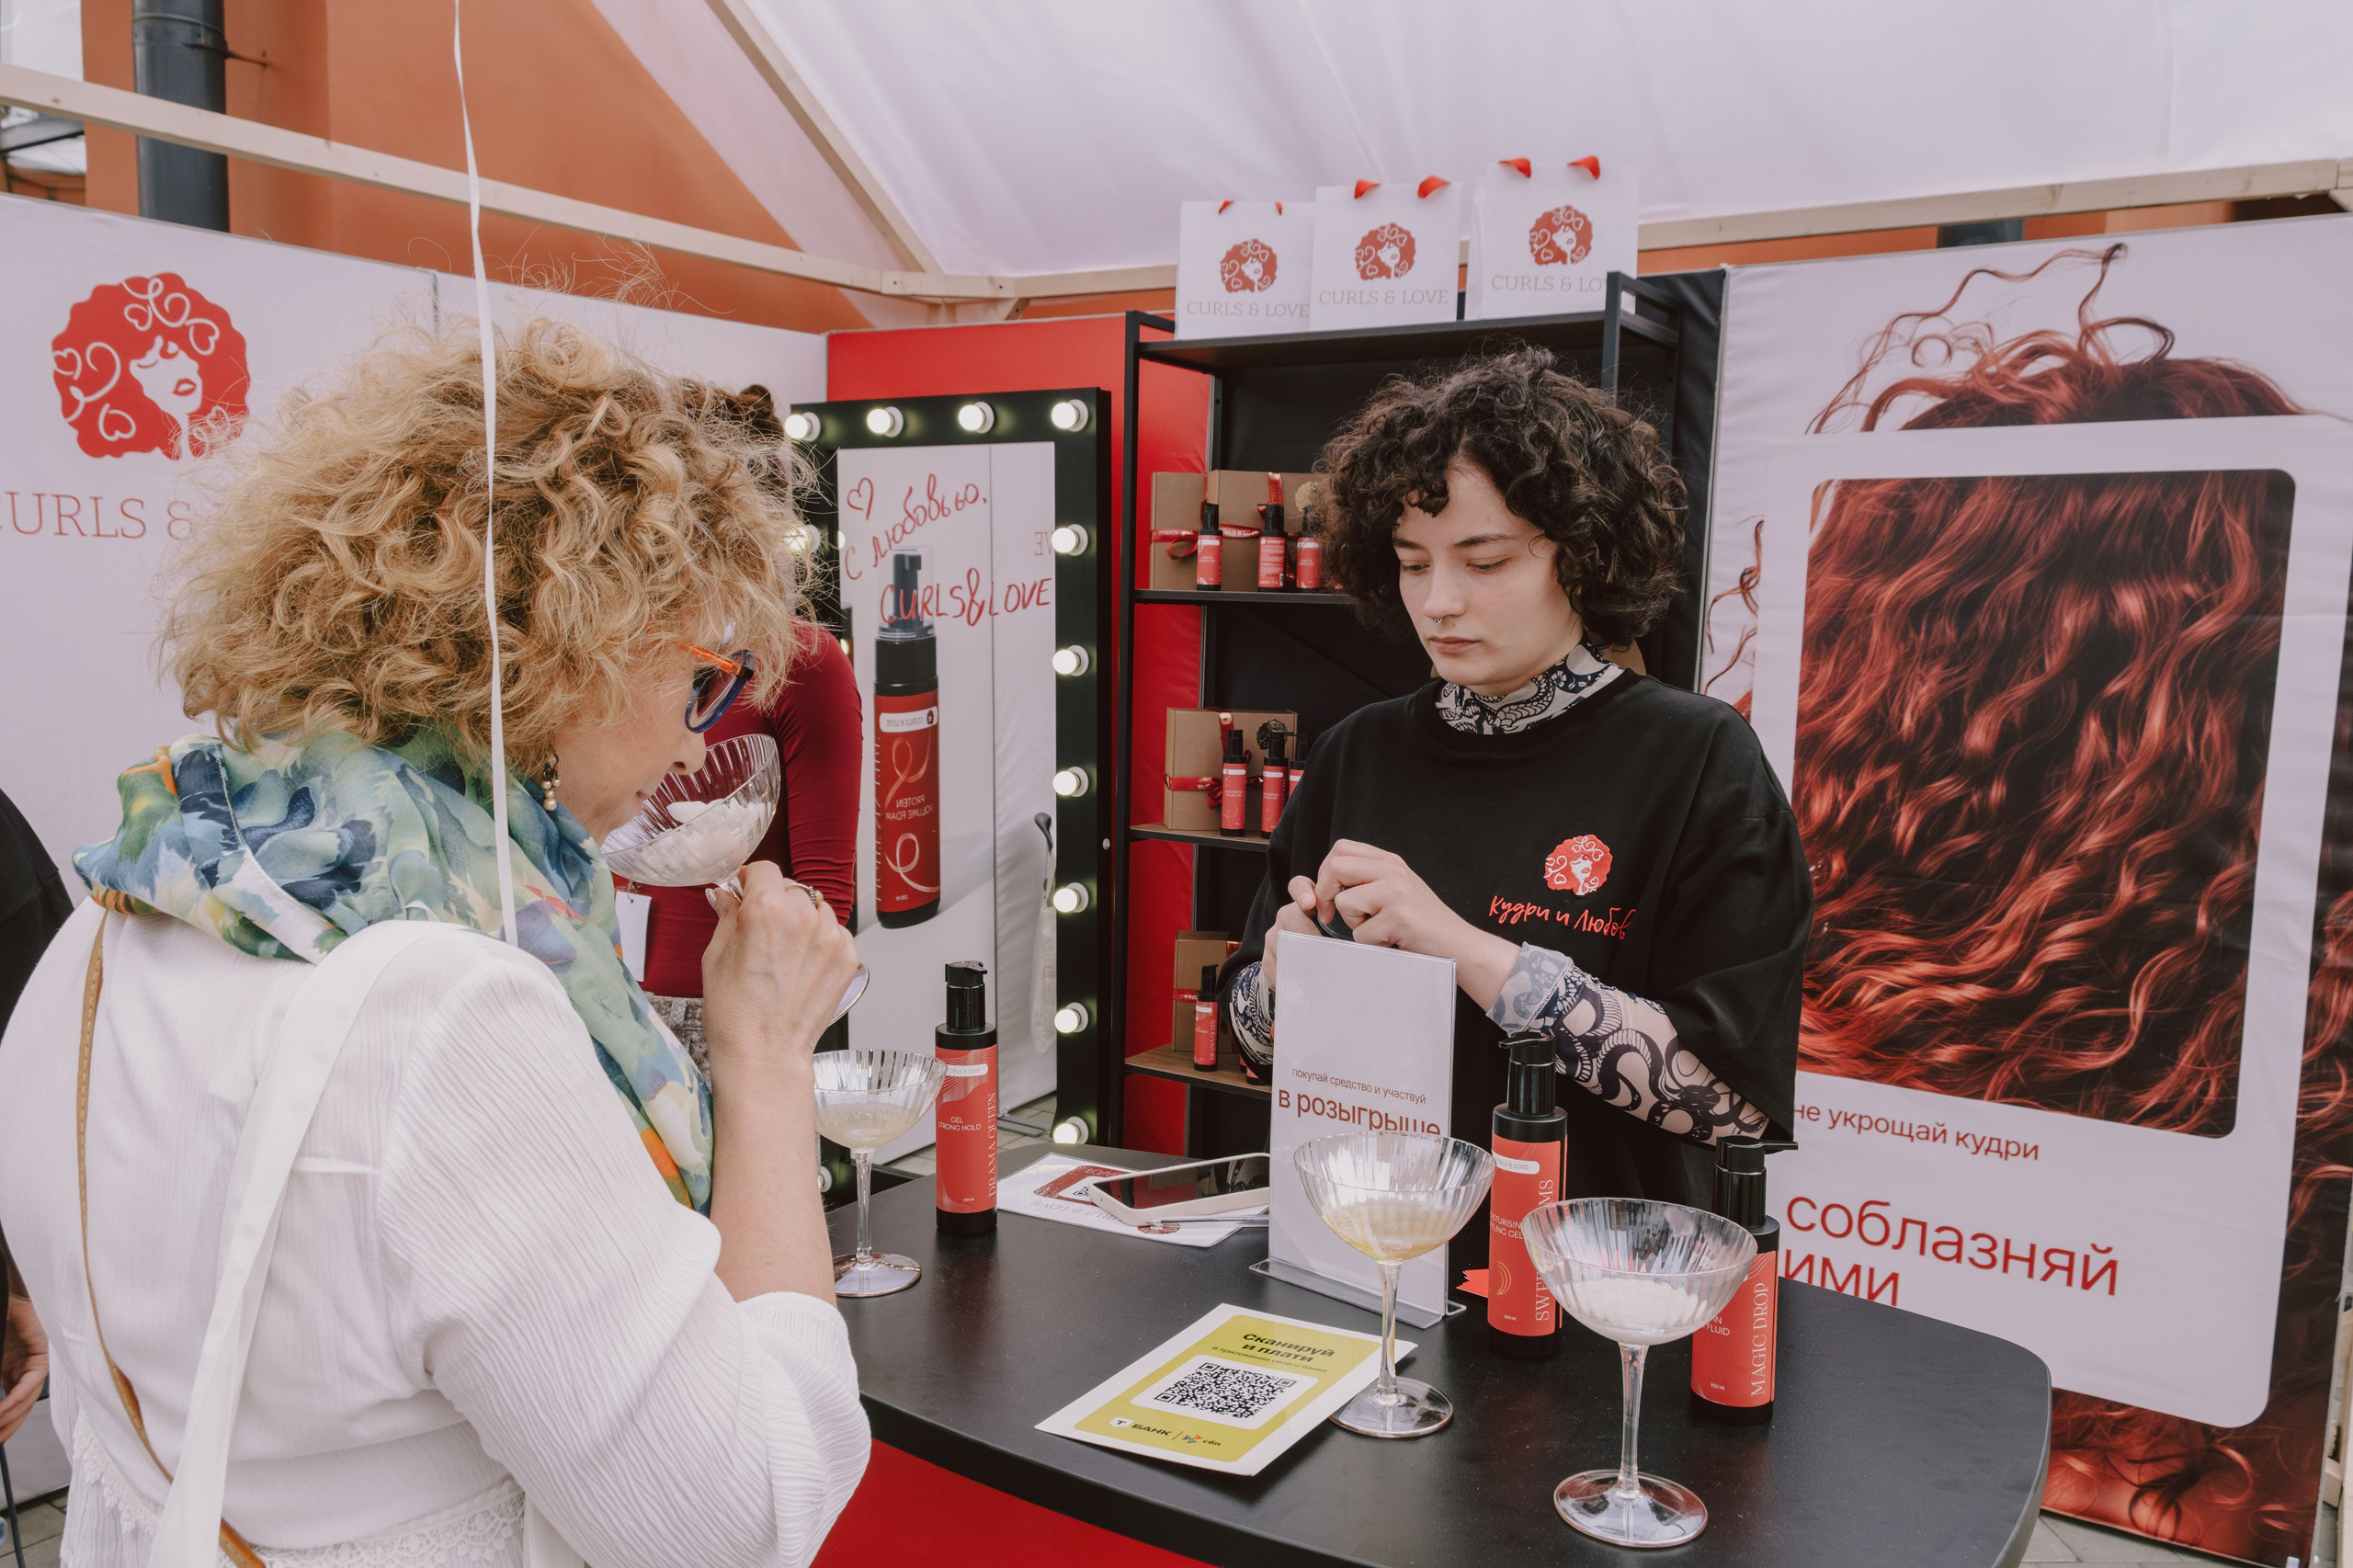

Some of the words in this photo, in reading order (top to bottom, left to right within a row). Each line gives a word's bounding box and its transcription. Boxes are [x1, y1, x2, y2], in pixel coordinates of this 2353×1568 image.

[1492, 275, 1553, 291] CURLS
[1561, 277, 1572, 292] &
[1579, 277, 1608, 293] LO
[1187, 301, 1244, 316] CURLS
[1248, 302, 1259, 316] &
[1265, 302, 1310, 318] LOVE
[1319, 290, 1379, 305] CURLS
[1384, 290, 1395, 304] &
[1402, 290, 1449, 305] LOVE
[0, 491, 147, 540] URLS
[1489, 894, 1551, 925] Кудри
[1556, 911, 1570, 926] и
[1279, 1089, 1291, 1108] в
[1291, 1068, 1328, 1084] покупай
[1329, 1075, 1373, 1094] средство
[1374, 1085, 1381, 1095] и
[1382, 1086, 1427, 1106] участвуй
[938, 1120, 961, 1132] STRONG
[961, 1123, 982, 1131] HOLD
[950, 1116, 964, 1124] GEL
[987, 1091, 996, 1139] QUEEN
[1827, 1106, 1948, 1144] укрощай
[1955, 1130, 2040, 1162] кудри
[988, 1141, 997, 1198] DRAMA
[1508, 1230, 1524, 1240] GEL
[1786, 1196, 2119, 1297] соблазняй
[1784, 1248, 1900, 1307] ими
[1753, 1282, 1769, 1331] DROP
[1706, 1323, 1731, 1336] FLUID
[1243, 1333, 1336, 1358] Сканируй
[1257, 1346, 1315, 1363] плати
[1219, 1347, 1271, 1362] приложении
[1271, 1358, 1302, 1369] своего
[1302, 1363, 1328, 1373] банка
[1751, 1335, 1768, 1398] MAGIC
[1131, 1423, 1174, 1437] БАНК
